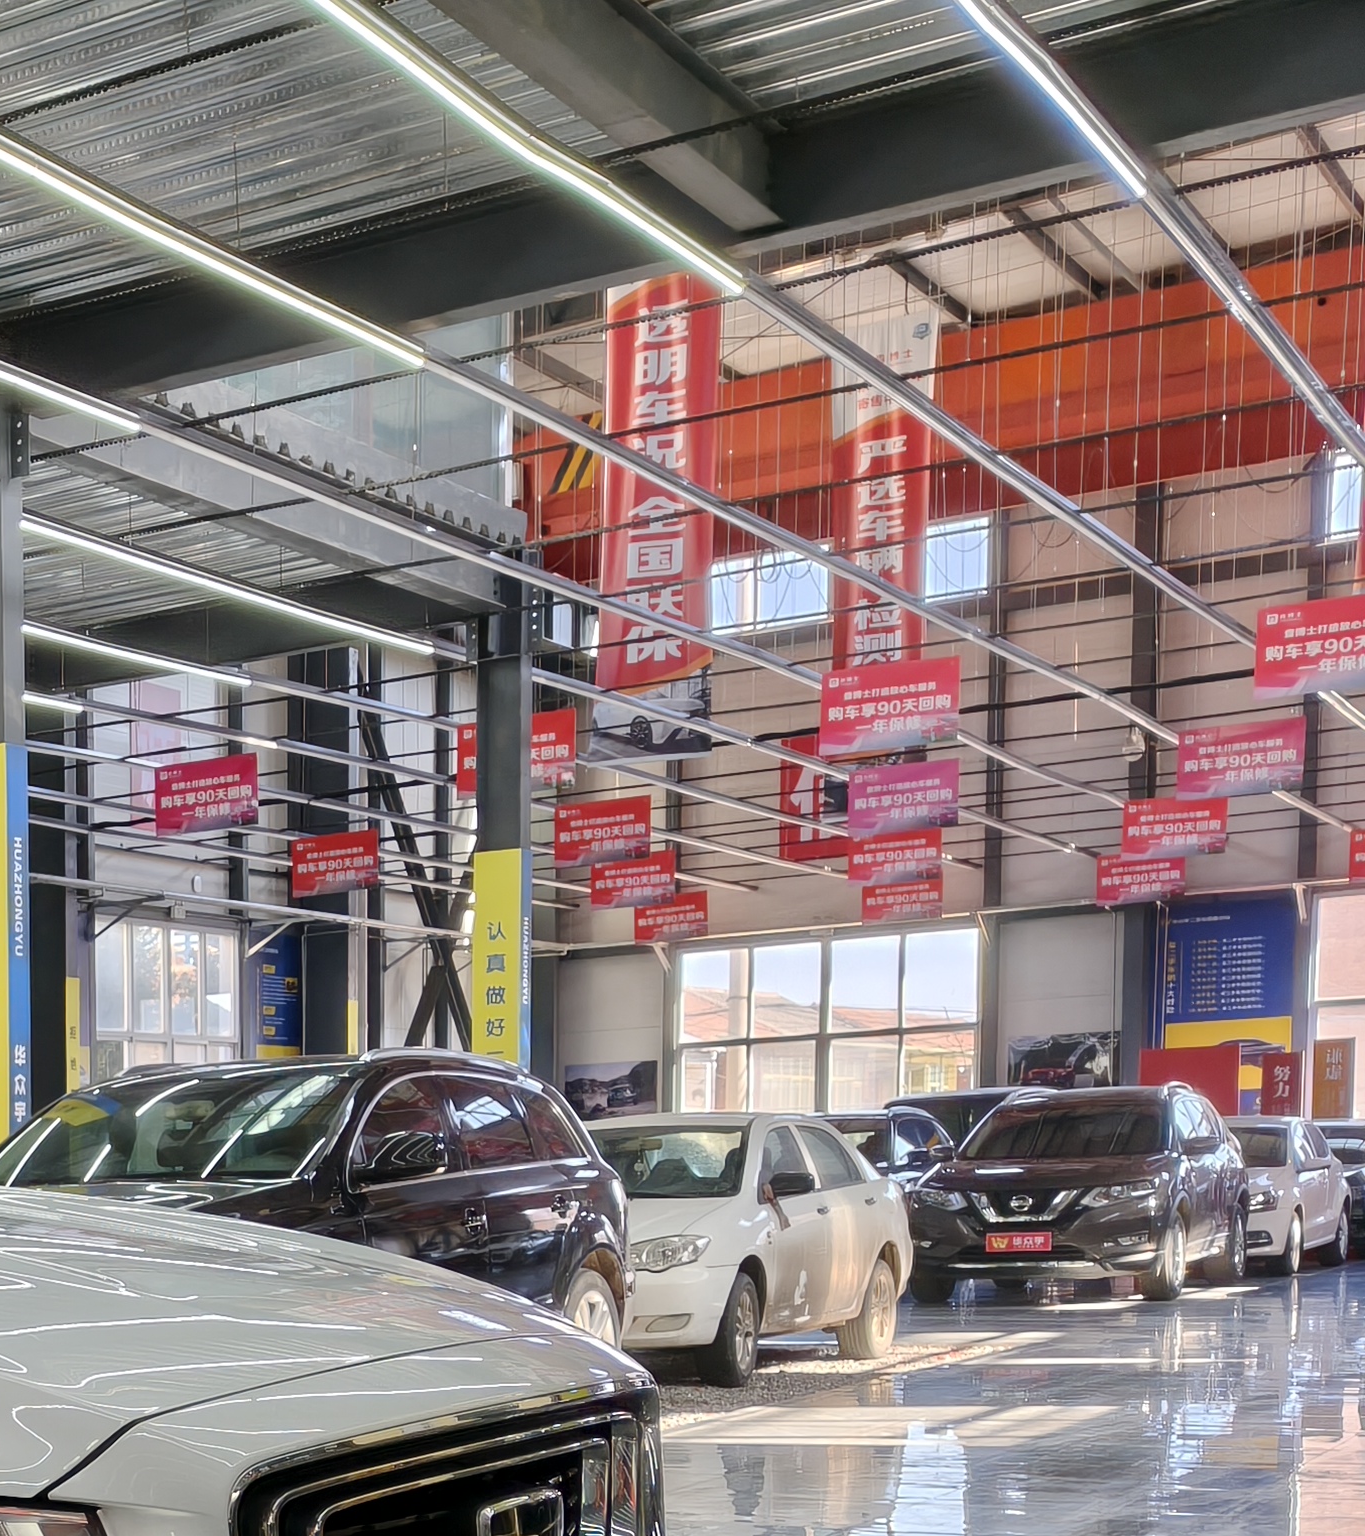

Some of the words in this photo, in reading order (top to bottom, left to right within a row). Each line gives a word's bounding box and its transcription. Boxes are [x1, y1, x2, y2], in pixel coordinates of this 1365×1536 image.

[828, 695, 951, 722] 购车享90天回购
[1184, 749, 1297, 772] 购车享90天回购
[161, 785, 252, 809] 购车享90天回购
[855, 788, 952, 810] 购车享90天回购
[13, 837, 23, 957] HUAZHONGYU
[14, 1045, 26, 1122] 华众宇
[1273, 1065, 1291, 1098] 努力
